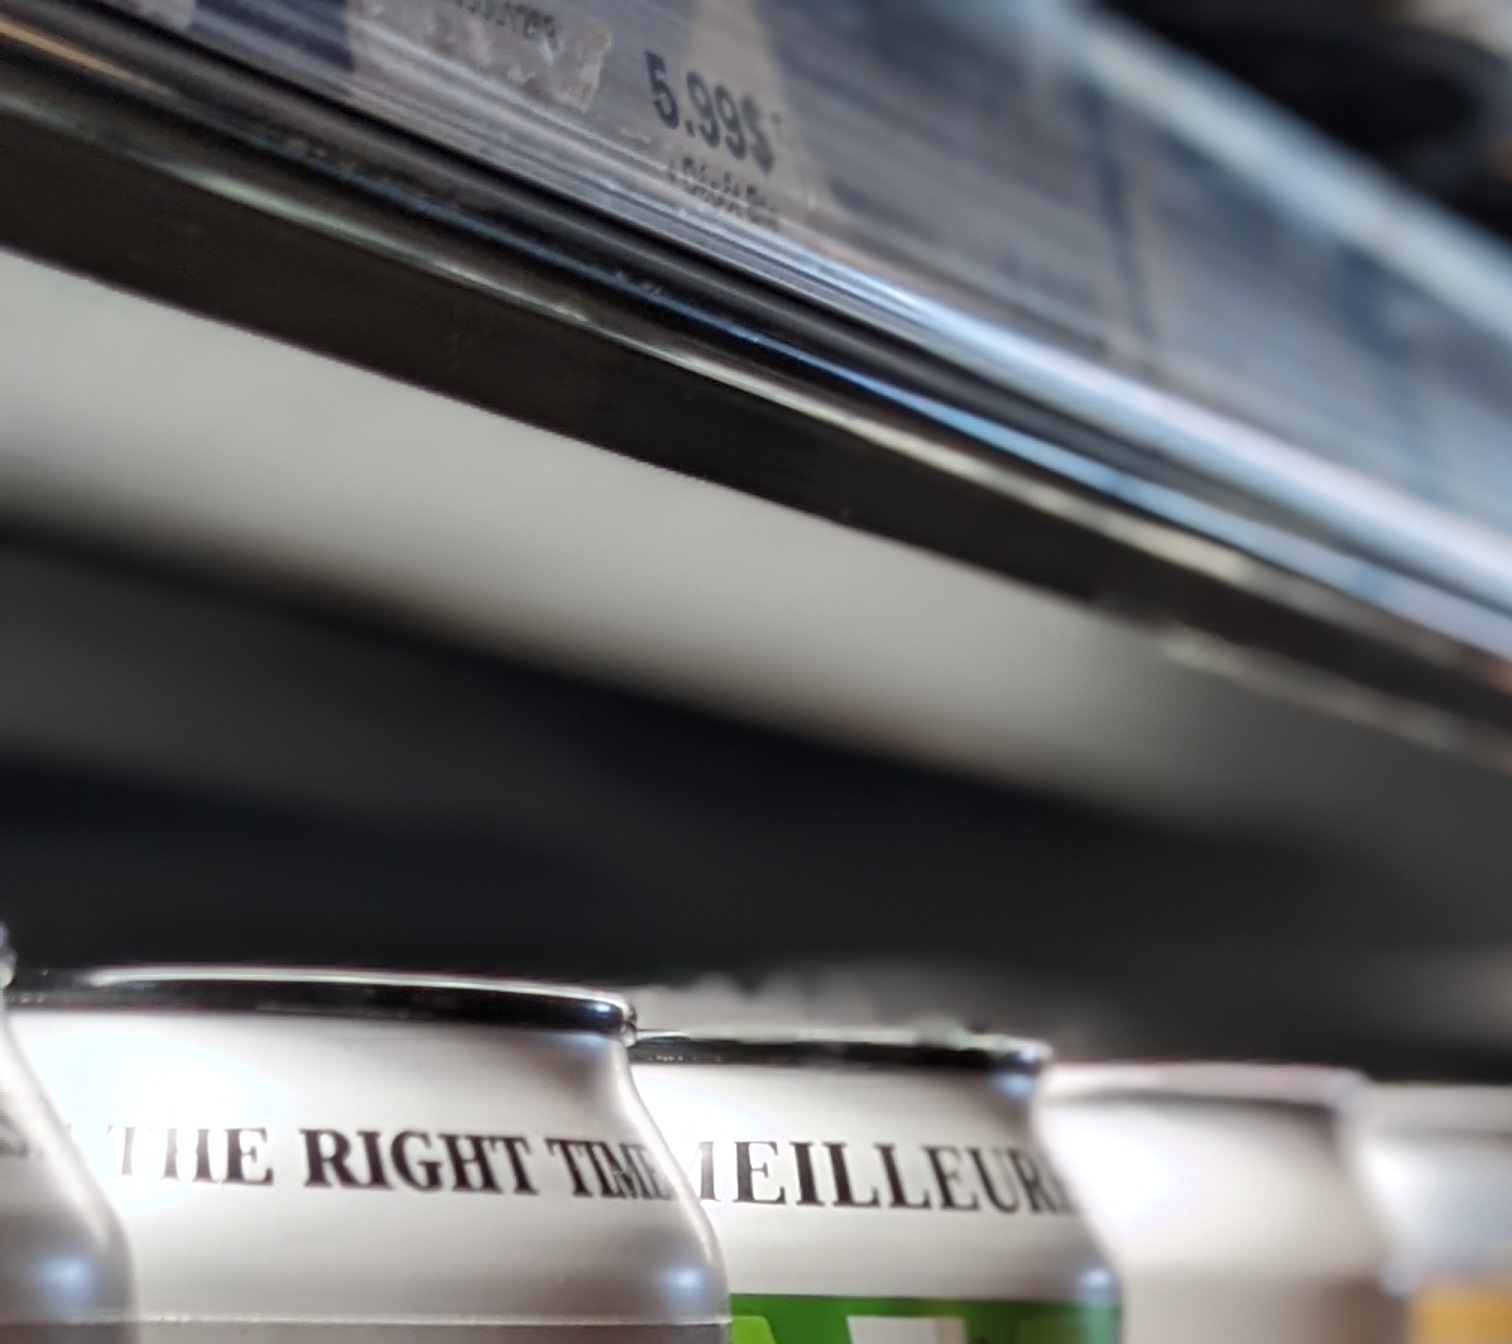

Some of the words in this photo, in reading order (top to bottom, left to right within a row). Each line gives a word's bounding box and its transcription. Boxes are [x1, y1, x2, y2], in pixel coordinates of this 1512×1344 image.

[645, 50, 774, 177] 5.99$
[107, 1124, 275, 1187] THE
[299, 1127, 541, 1197] RIGHT
